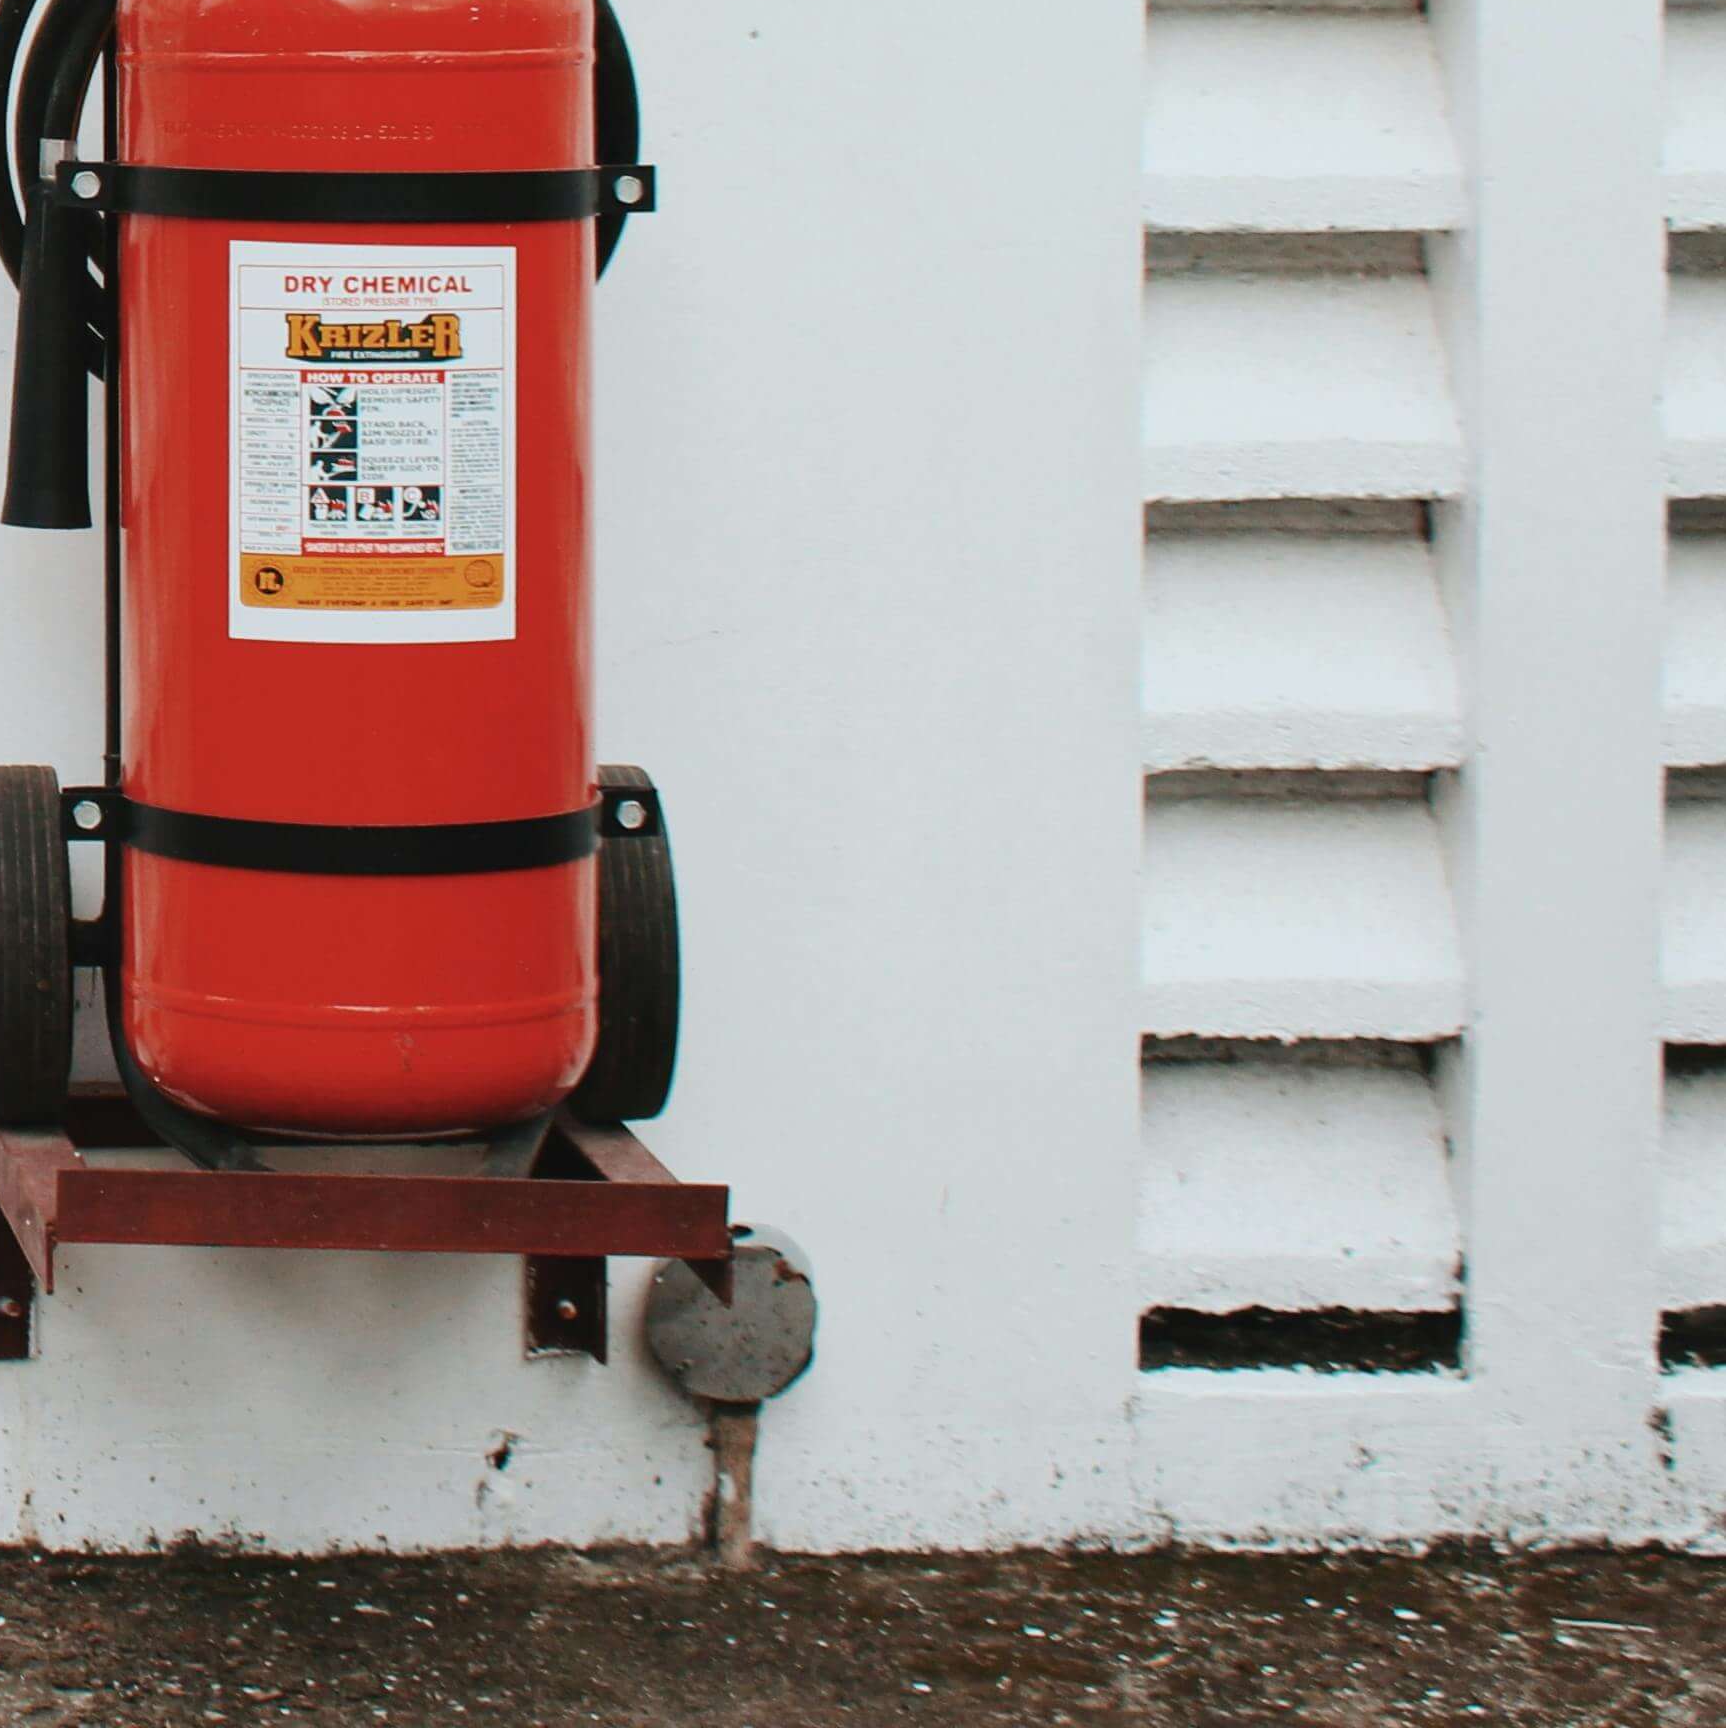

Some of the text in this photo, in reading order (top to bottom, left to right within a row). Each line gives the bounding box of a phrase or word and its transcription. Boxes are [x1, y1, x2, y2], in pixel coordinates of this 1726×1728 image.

[284, 275, 472, 293] DRY CHEMICAL
[286, 313, 462, 359] KRIZLER
[307, 373, 439, 384] HOW TO OPERATE
